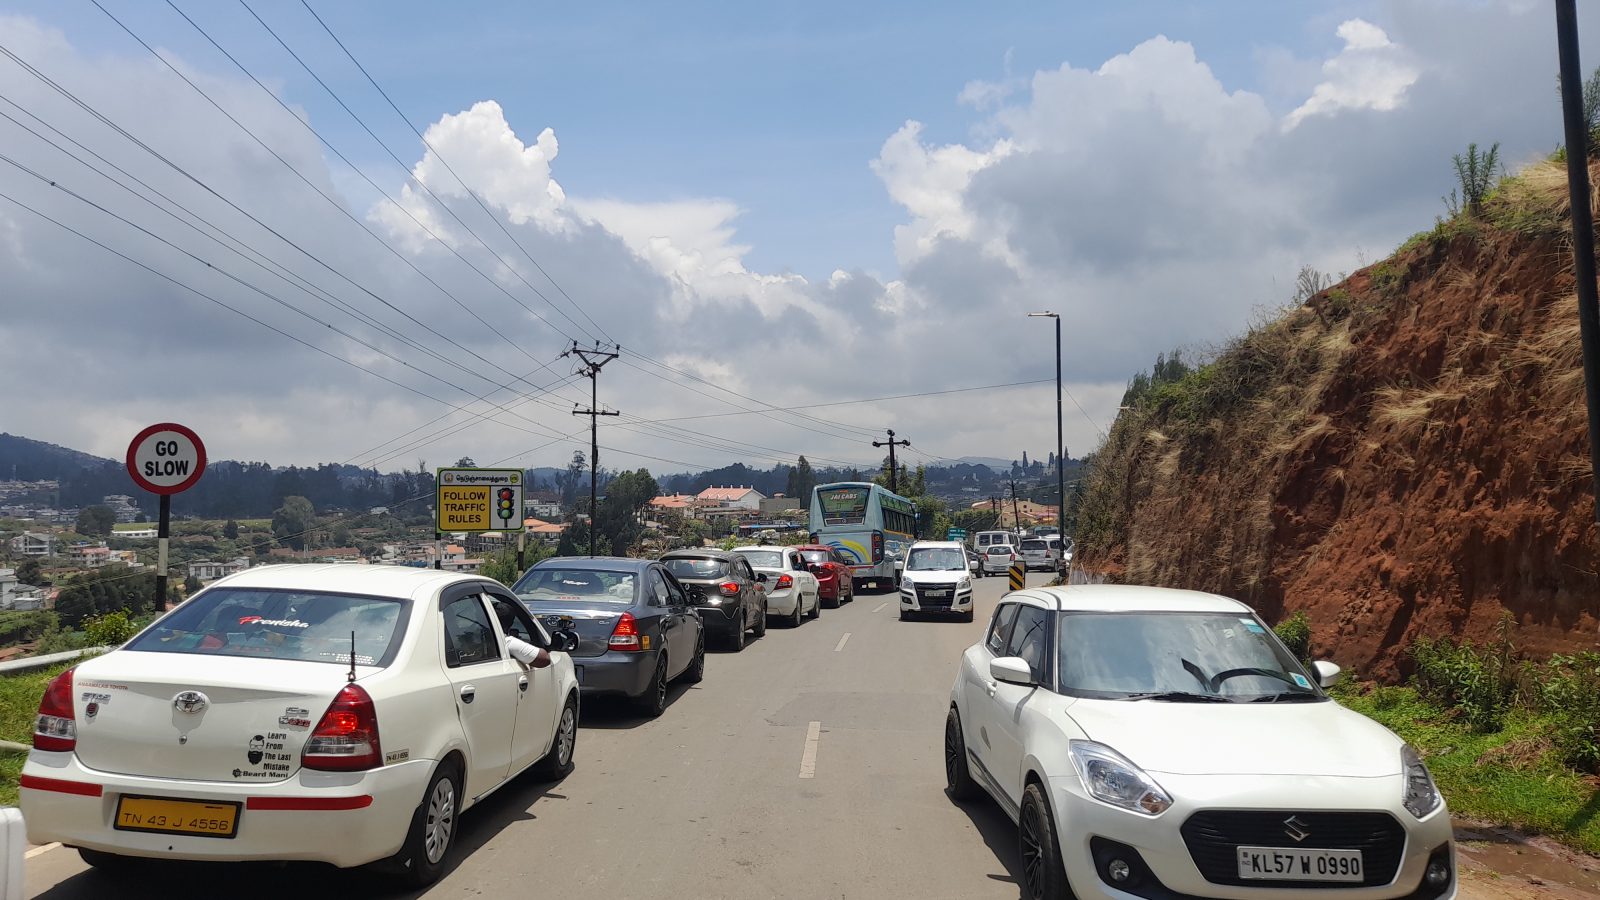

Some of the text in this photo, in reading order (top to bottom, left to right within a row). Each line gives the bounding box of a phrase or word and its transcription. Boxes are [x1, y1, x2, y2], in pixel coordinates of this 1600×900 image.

[155, 441, 178, 456] GO
[144, 460, 189, 476] SLOW
[444, 492, 486, 500] FOLLOW
[444, 504, 486, 512] TRAFFIC
[448, 514, 482, 523] RULES
[267, 732, 287, 740] Learn
[265, 742, 284, 750] From
[264, 752, 292, 761] The Last
[263, 762, 290, 771] Mistake
[124, 812, 229, 831] TN 43 J 4556
[1252, 854, 1360, 875] KL57 W 0990
